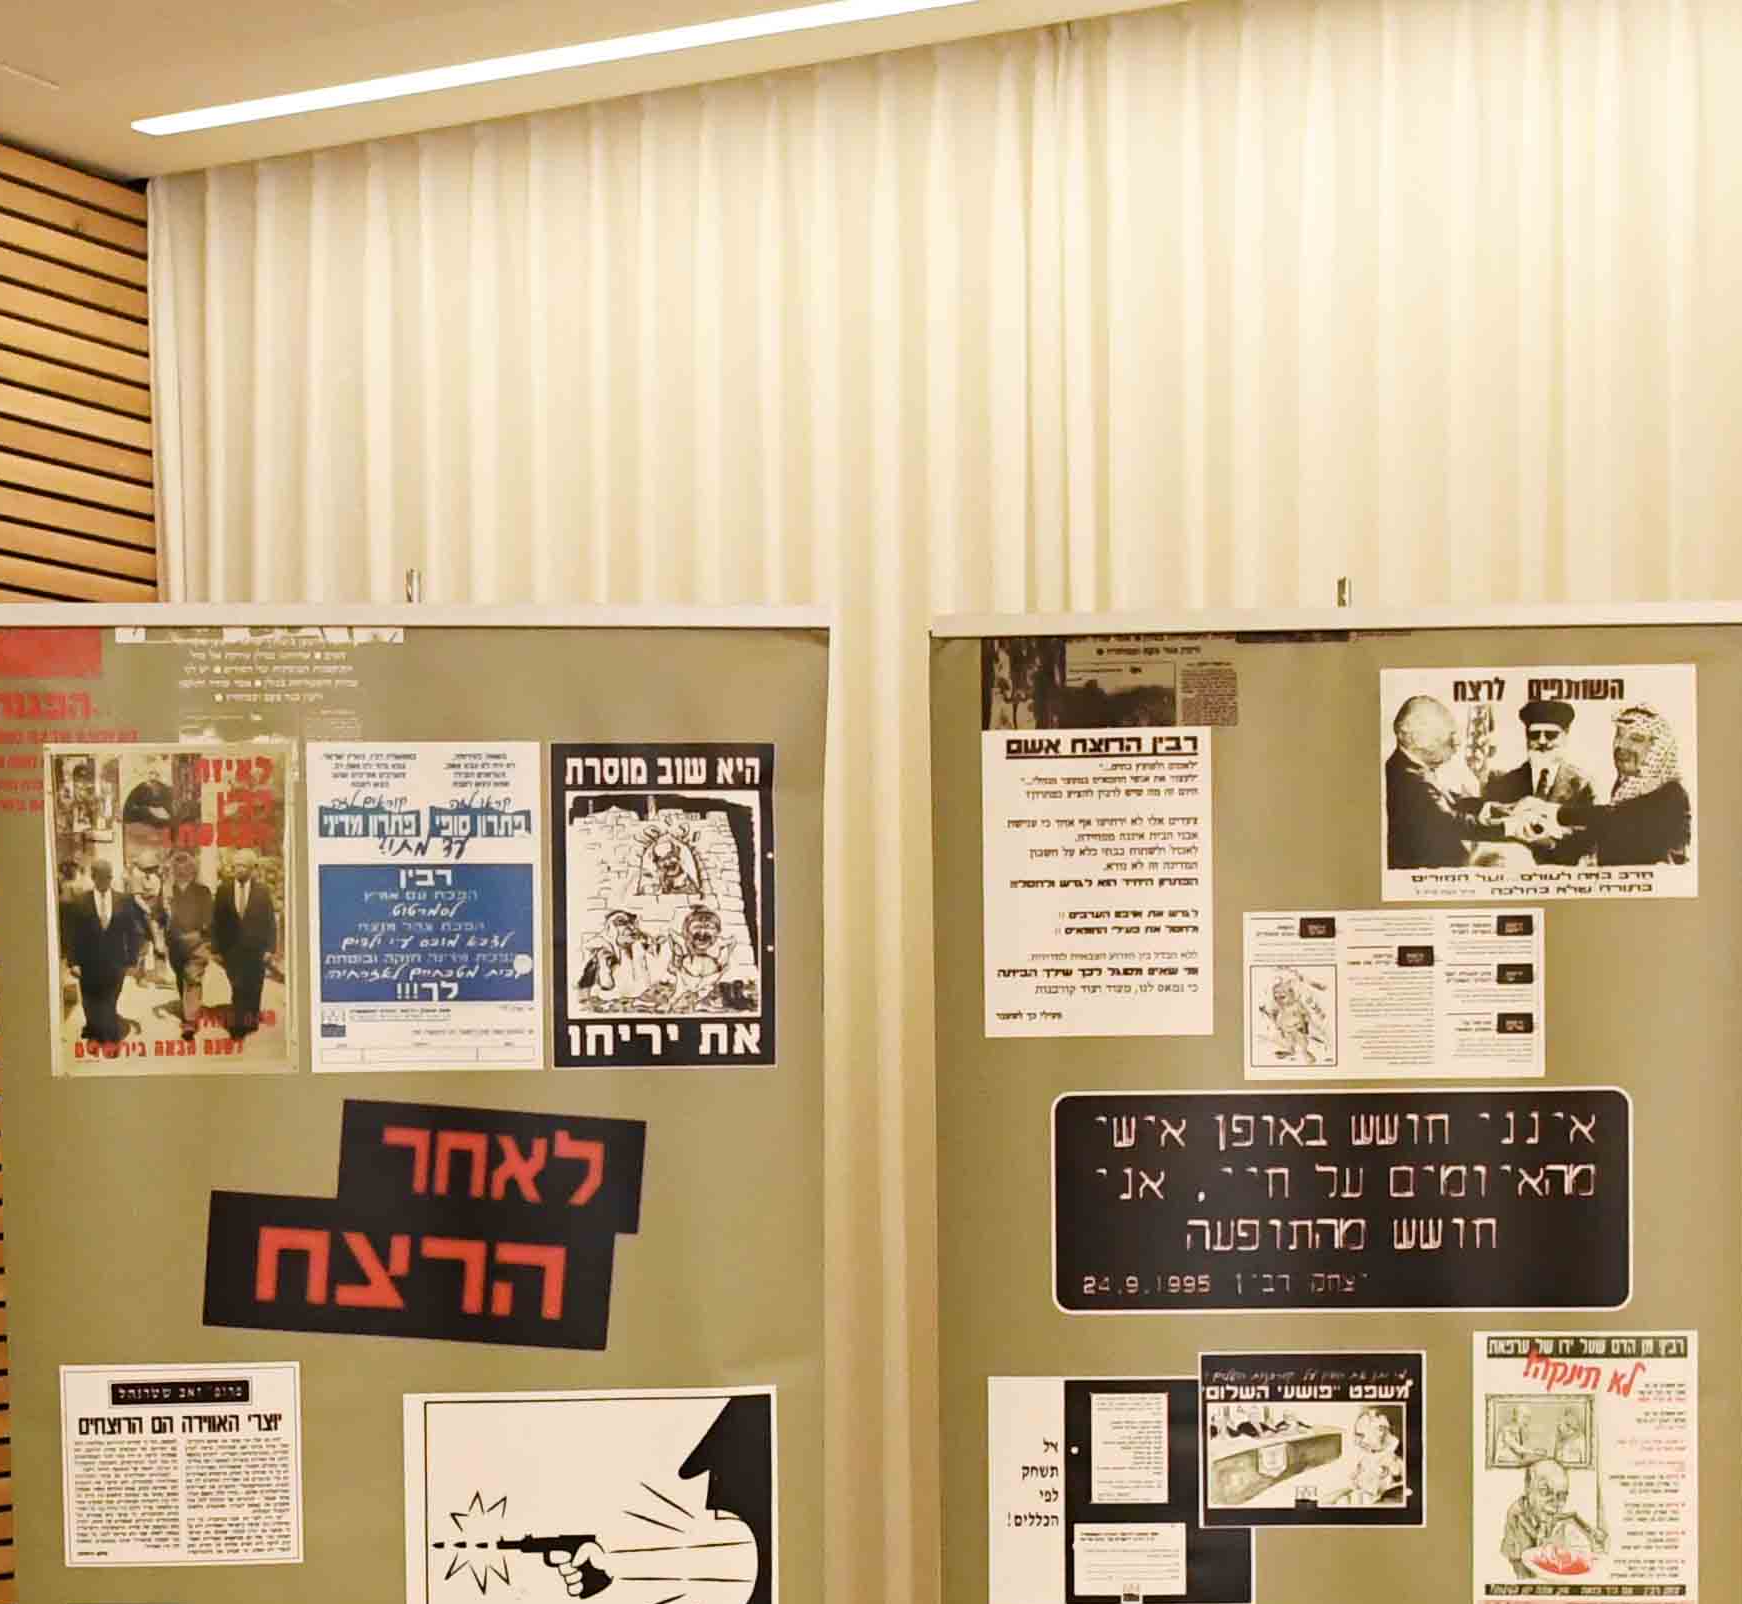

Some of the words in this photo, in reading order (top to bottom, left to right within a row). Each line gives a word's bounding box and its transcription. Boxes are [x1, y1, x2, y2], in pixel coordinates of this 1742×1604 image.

[1453, 679, 1506, 702] לרצח
[1006, 738, 1061, 754] אשם
[1070, 737, 1142, 754] הרוצח
[1151, 736, 1198, 754] רבין
[565, 757, 647, 785] מוסרת
[657, 757, 706, 785] שוב
[717, 757, 760, 784] היא
[399, 868, 451, 888] רבין
[569, 1024, 679, 1056] יריחו
[699, 1023, 760, 1055] את
[1093, 1115, 1186, 1150] אישי
[1211, 1113, 1328, 1151] באופן
[1350, 1113, 1450, 1146] חושש
[382, 1124, 604, 1207] לאחר
[1314, 1164, 1364, 1197] על
[1095, 1166, 1164, 1200] אני
[1185, 1217, 1366, 1252] מהתופעה
[1393, 1217, 1497, 1249] חושש
[255, 1225, 568, 1319] הרצח
[1608, 1362, 1646, 1397] לא
[78, 1417, 143, 1436] הרוצחים
[151, 1415, 174, 1434] הם
